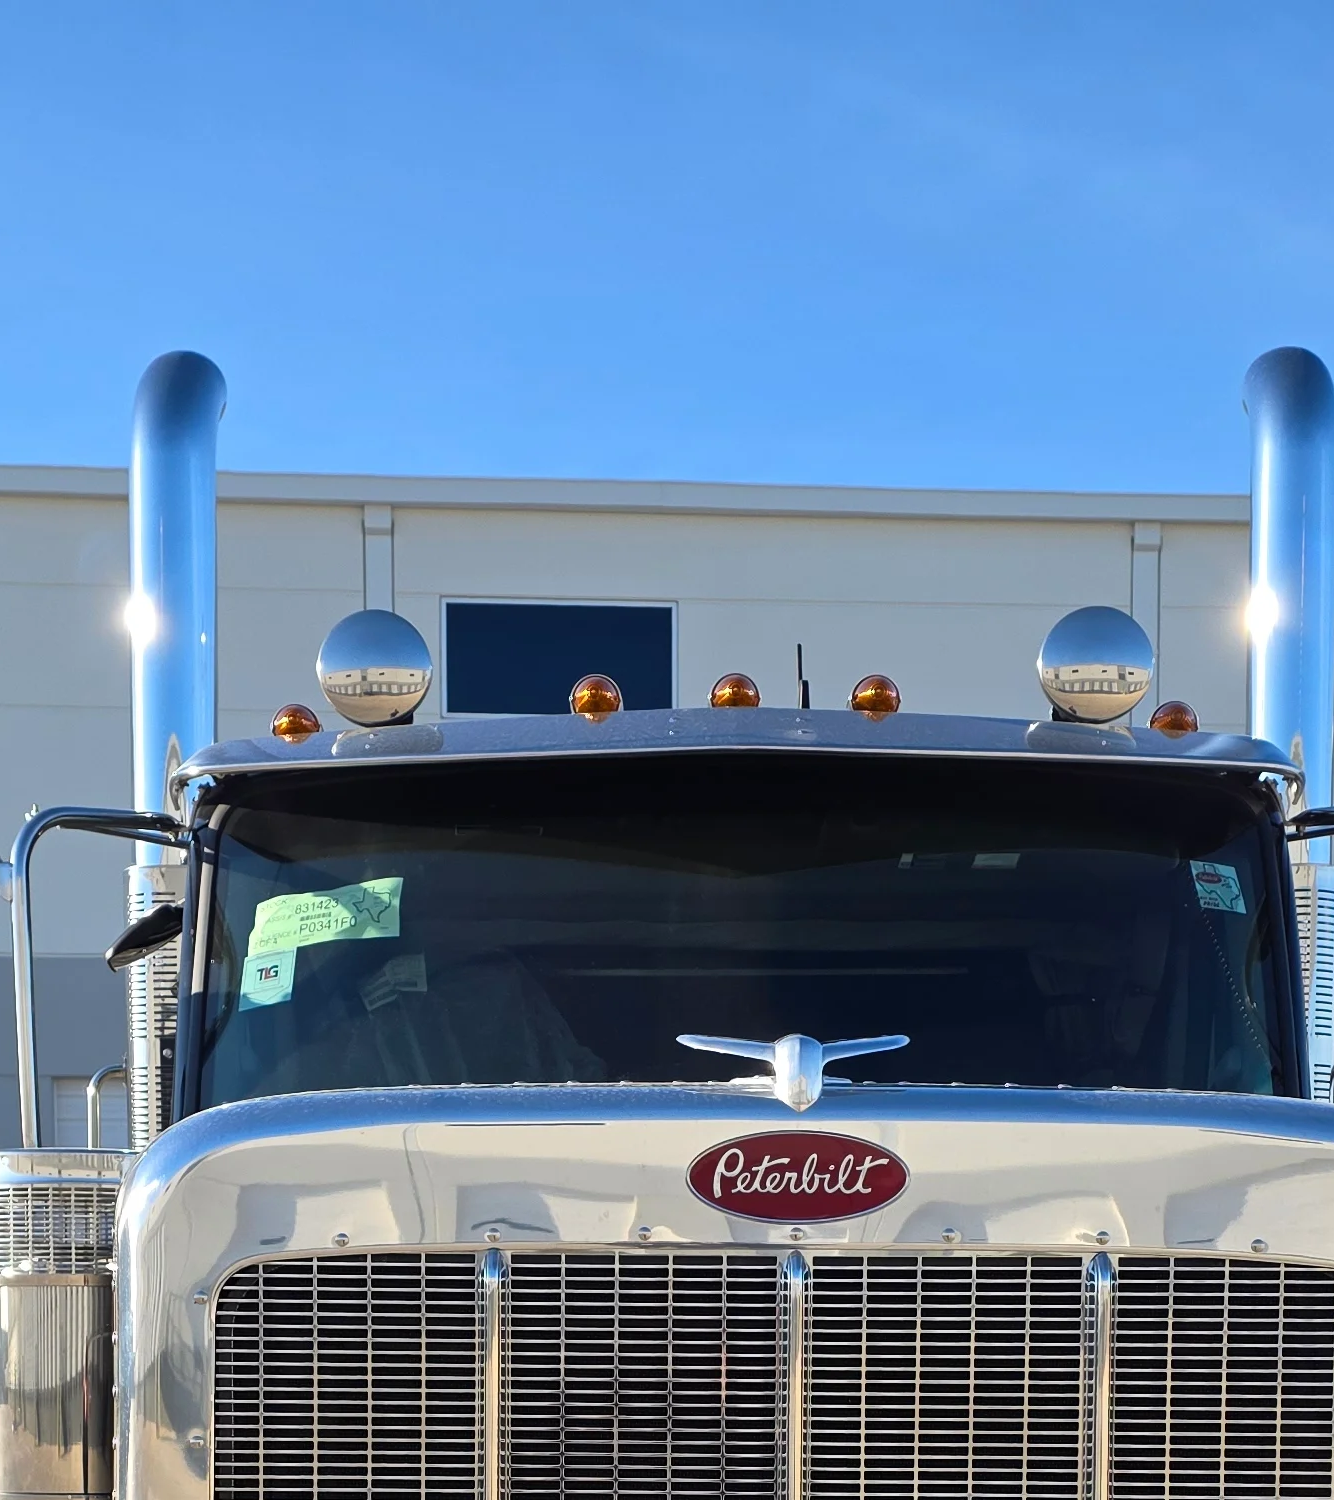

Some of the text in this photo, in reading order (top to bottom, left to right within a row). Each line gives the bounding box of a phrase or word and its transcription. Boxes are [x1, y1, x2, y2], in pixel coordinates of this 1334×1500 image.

[294, 898, 340, 915] 831423
[299, 915, 358, 936] P0341F0
[256, 965, 279, 981] TLG
[712, 1148, 890, 1199] Peterbilt
